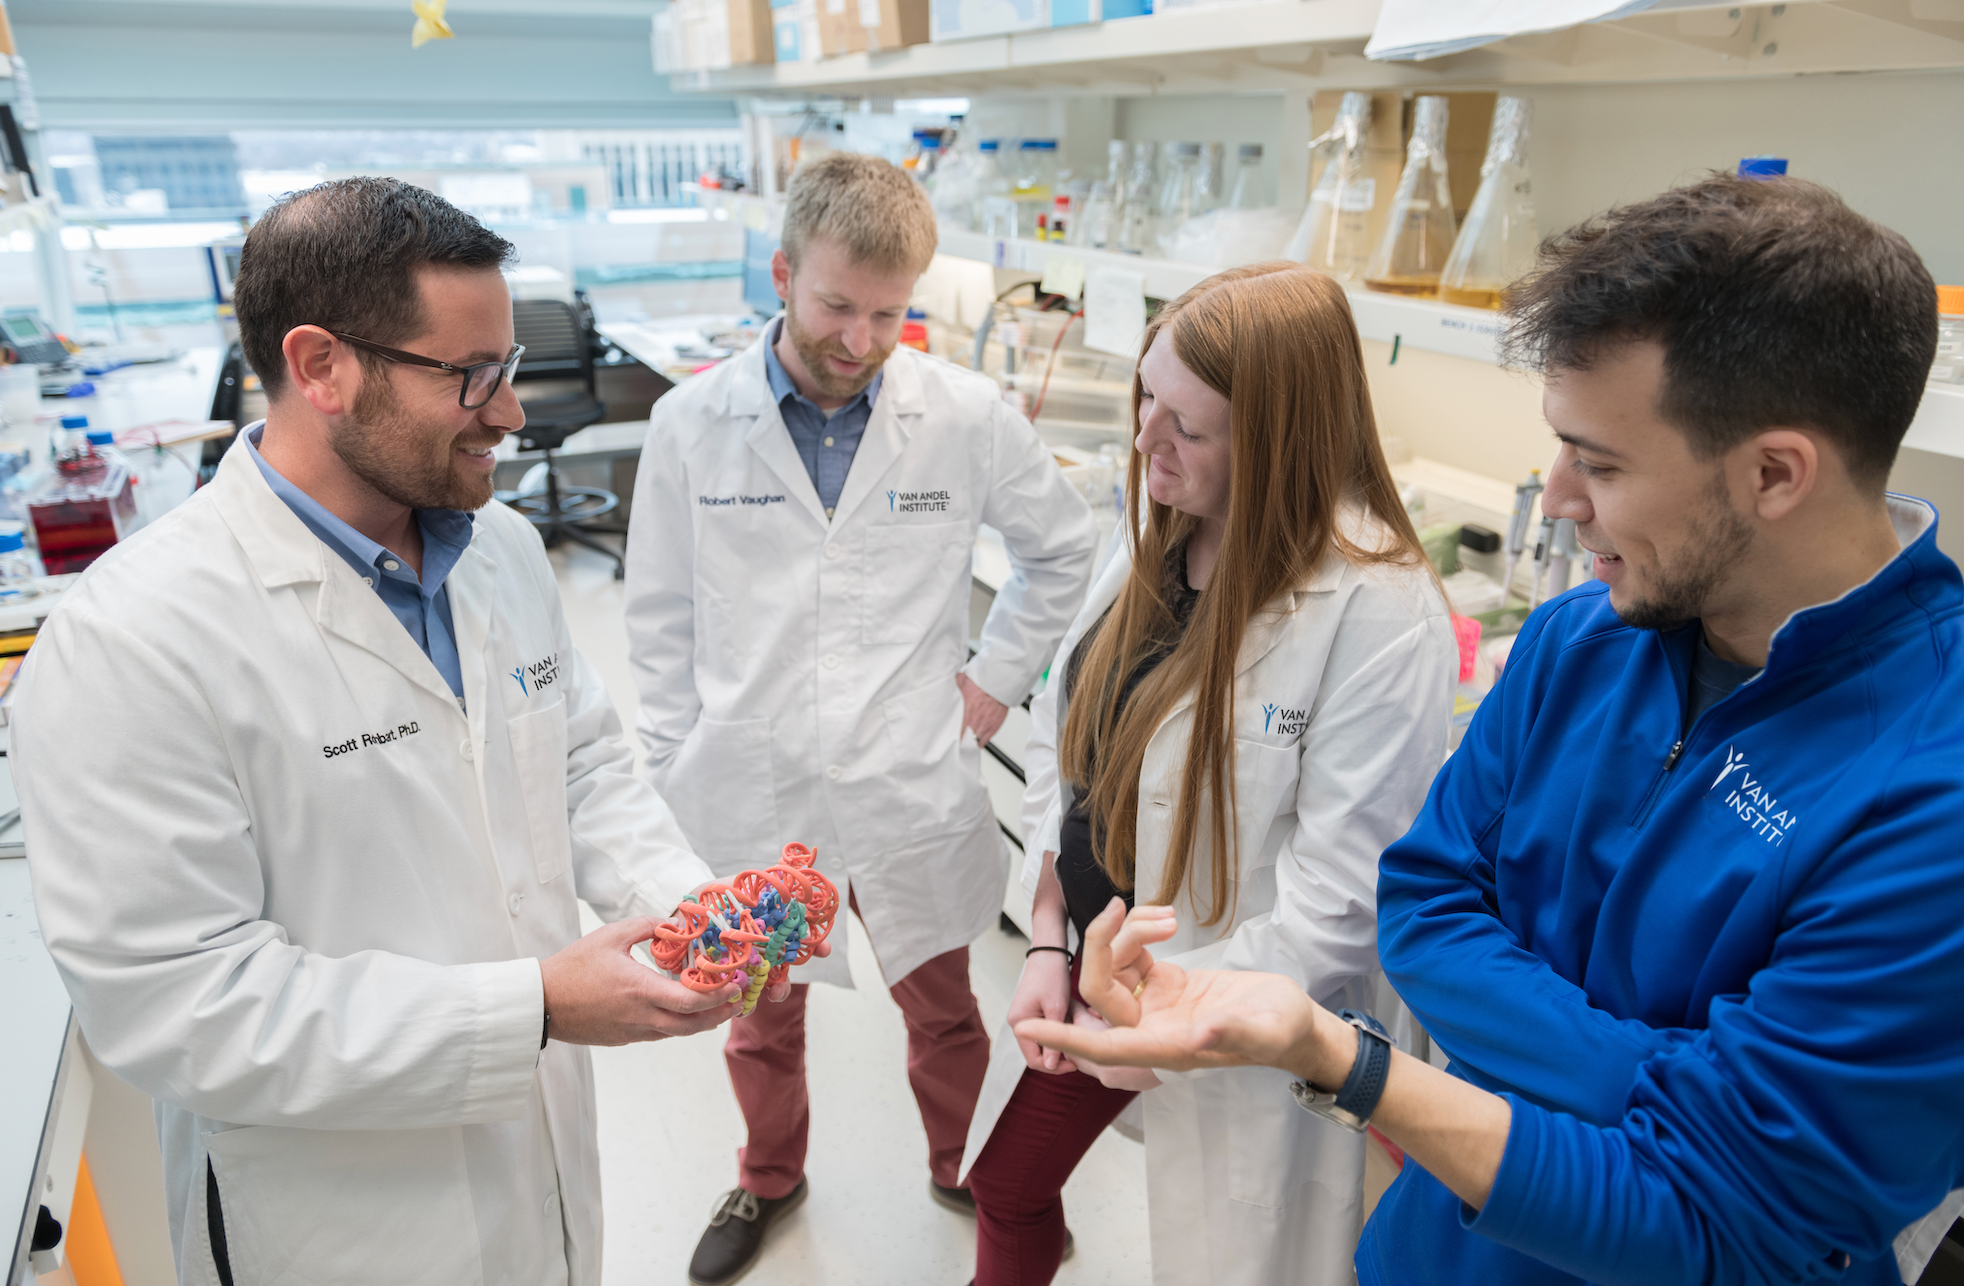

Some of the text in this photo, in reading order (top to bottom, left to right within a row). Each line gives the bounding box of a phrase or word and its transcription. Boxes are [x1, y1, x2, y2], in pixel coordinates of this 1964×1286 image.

[699, 494, 785, 506] Robert Vaughan
[898, 490, 951, 501] VAN ANDEL
[528, 655, 552, 676] VAN
[1280, 709, 1306, 721] VAN
[323, 738, 358, 758] Scott
[1741, 771, 1777, 813] VAN
[1724, 789, 1786, 848] INSTIT
